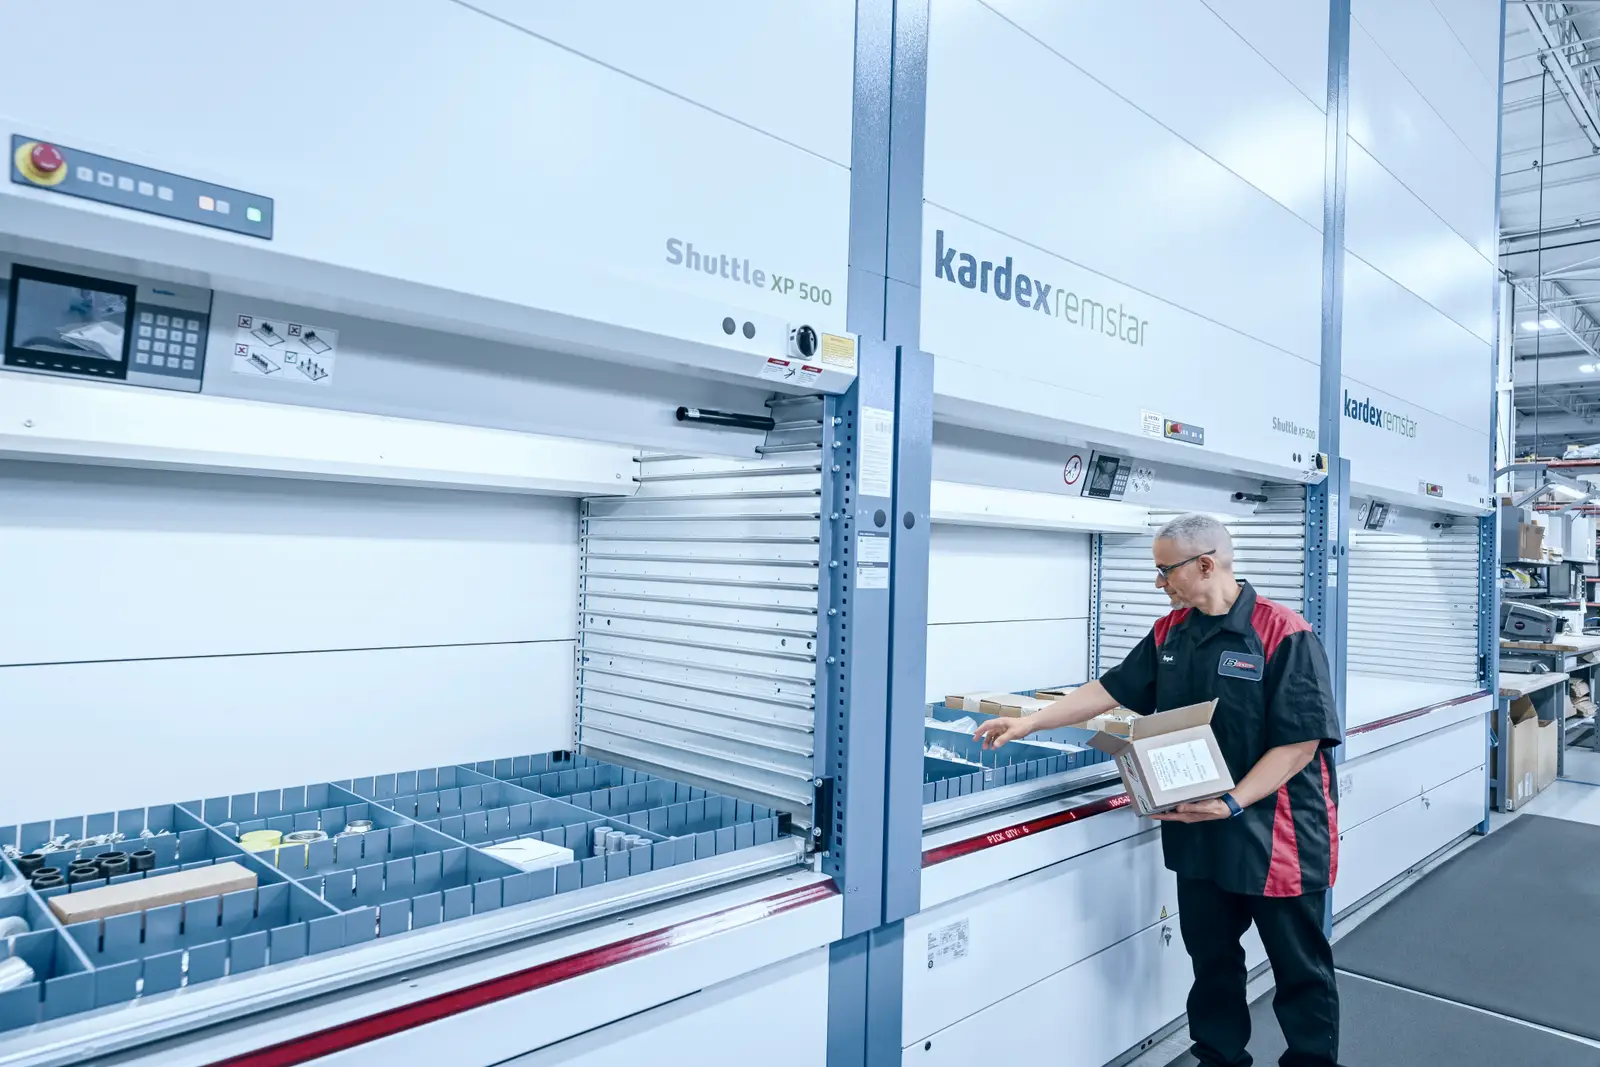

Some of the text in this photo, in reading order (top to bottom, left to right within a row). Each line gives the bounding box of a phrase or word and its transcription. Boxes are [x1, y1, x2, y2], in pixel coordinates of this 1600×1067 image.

[665, 237, 833, 306] Shuttle XP 500
[1272, 416, 1298, 436] Shuttle
[986, 832, 1006, 844] PICK
[1022, 825, 1029, 833] 6
